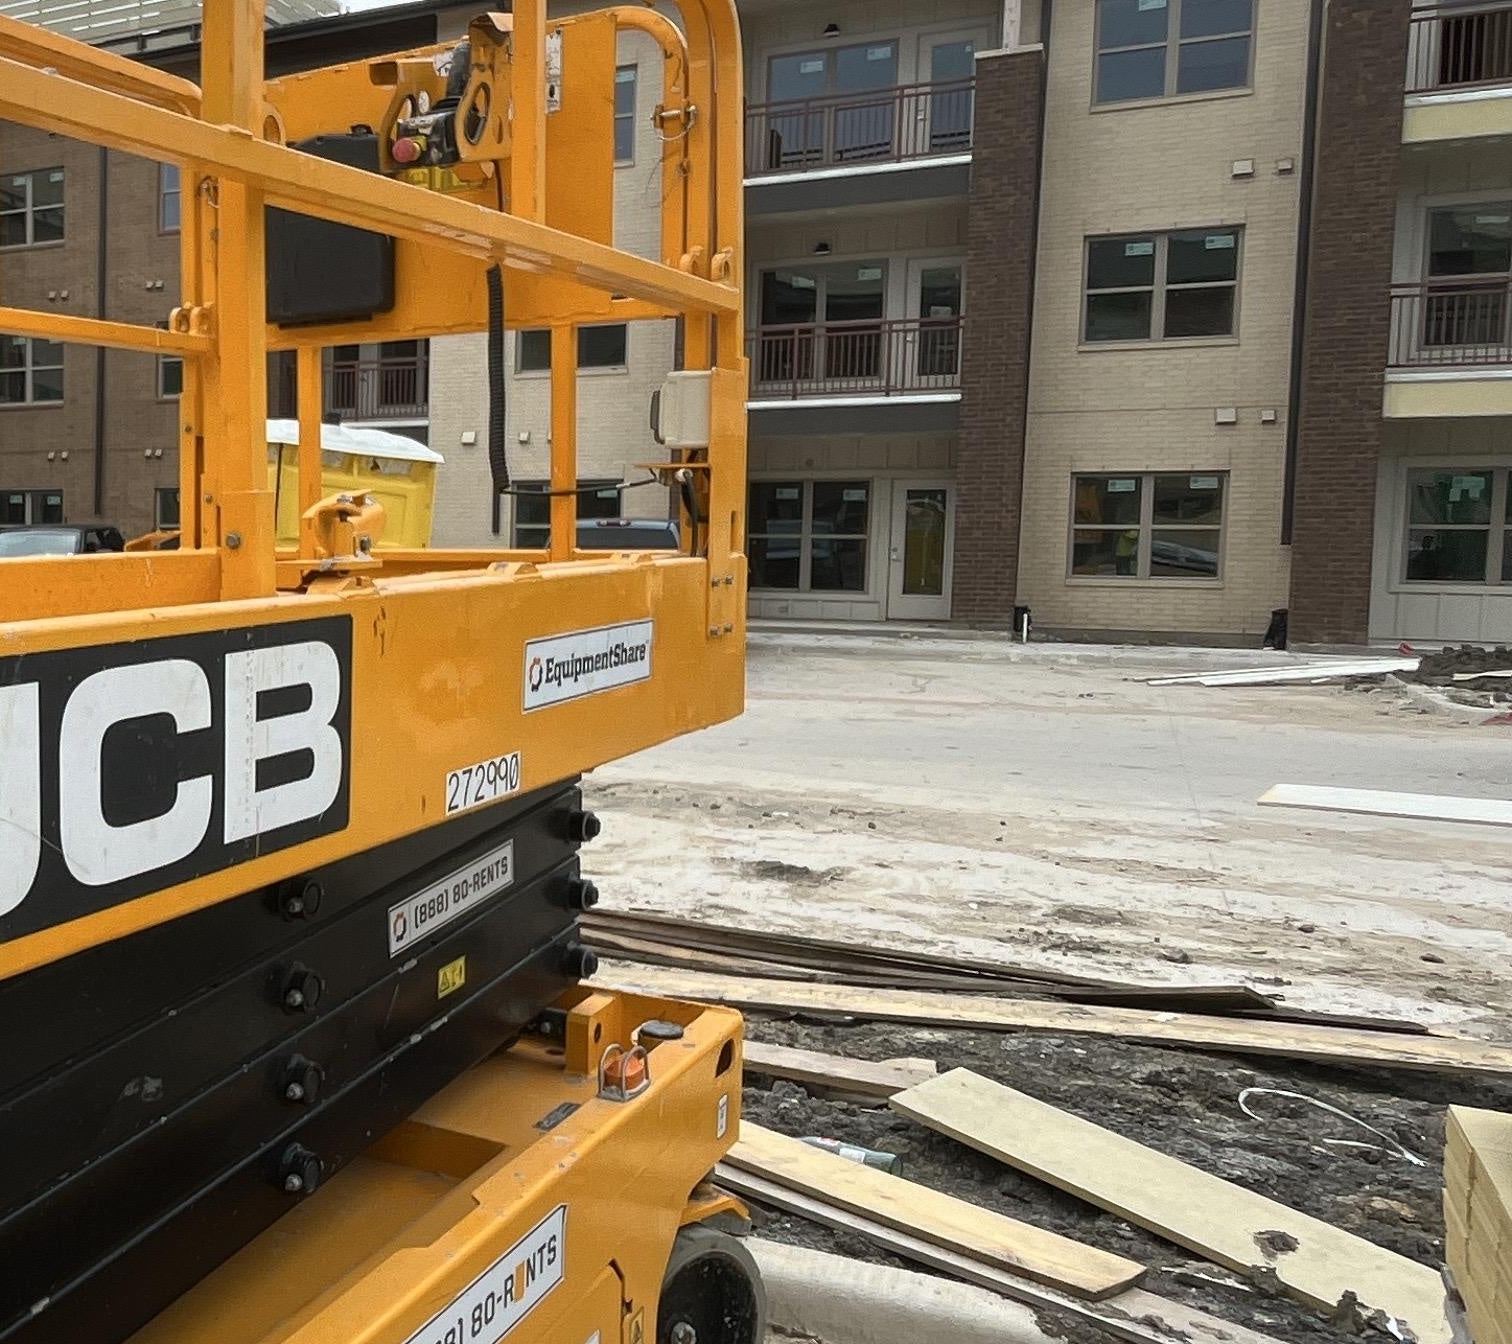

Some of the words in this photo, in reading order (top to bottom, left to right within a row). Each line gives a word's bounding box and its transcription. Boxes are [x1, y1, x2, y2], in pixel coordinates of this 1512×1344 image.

[544, 641, 647, 684] EquipmentShare
[447, 754, 519, 811] 272990
[414, 888, 450, 929] (888)
[452, 855, 509, 904] 80-RENTS
[470, 1234, 558, 1339] 80-RNTS
